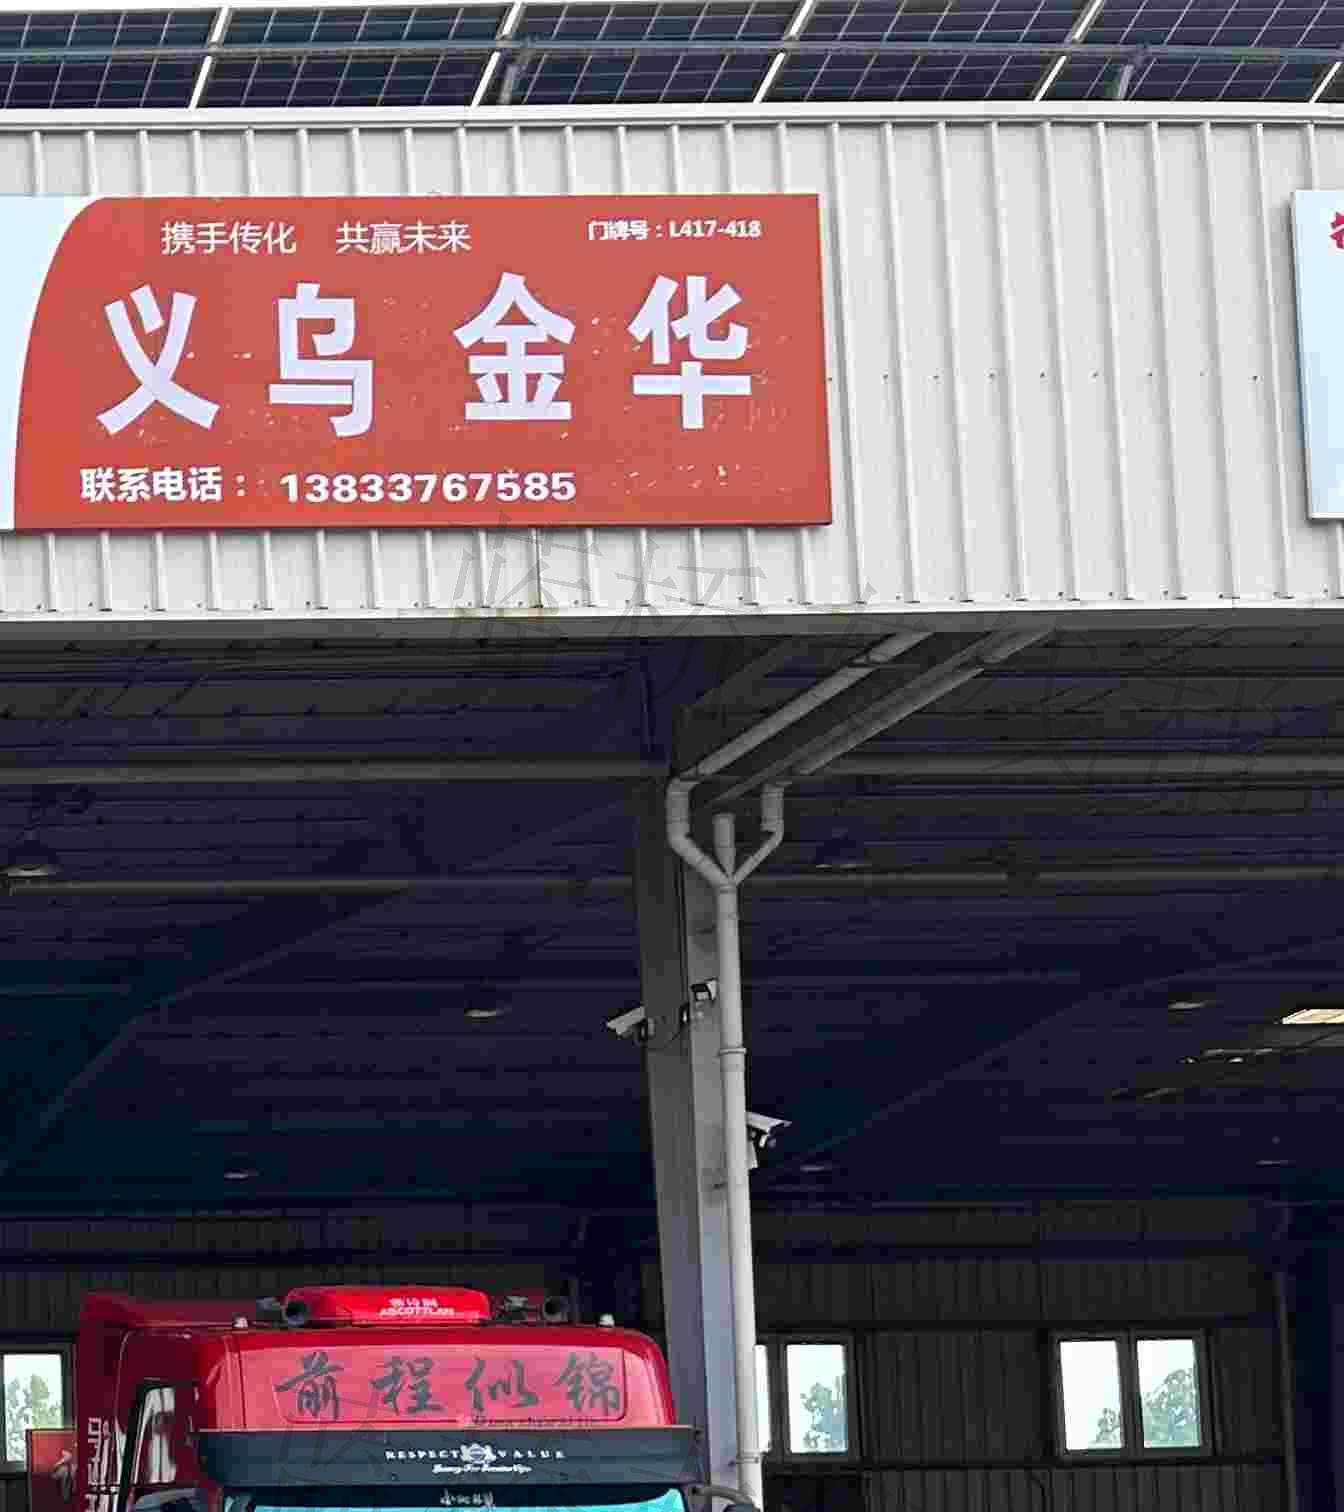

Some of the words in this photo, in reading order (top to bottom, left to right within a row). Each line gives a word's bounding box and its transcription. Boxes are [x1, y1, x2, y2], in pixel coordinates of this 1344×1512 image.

[161, 220, 296, 255] 携手传化
[336, 219, 472, 254] 共赢未来
[279, 471, 577, 504] 13833767585
[274, 1350, 623, 1424] 前程似锦
